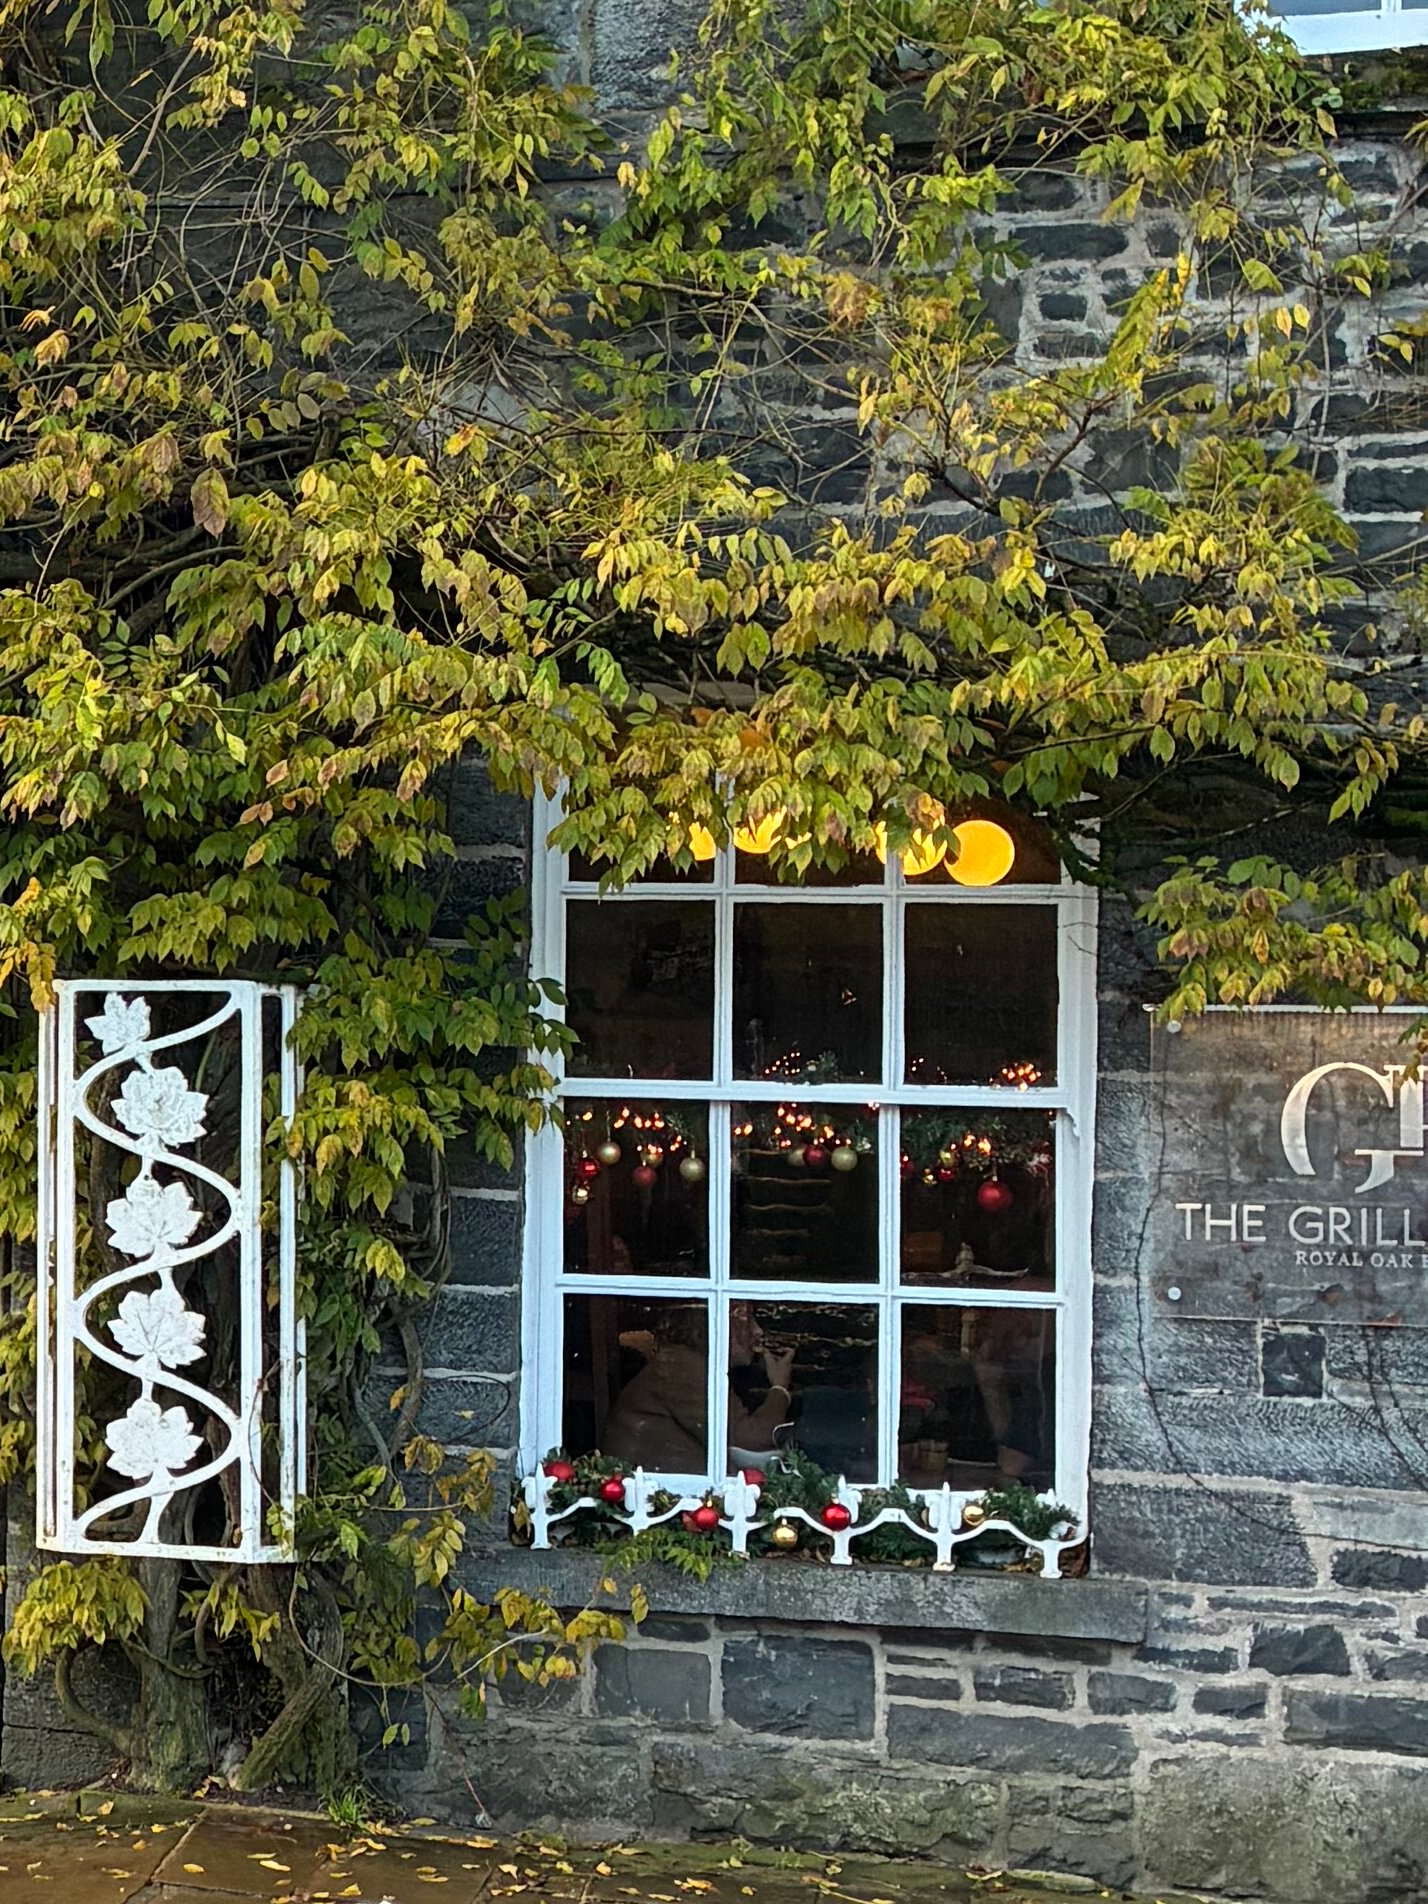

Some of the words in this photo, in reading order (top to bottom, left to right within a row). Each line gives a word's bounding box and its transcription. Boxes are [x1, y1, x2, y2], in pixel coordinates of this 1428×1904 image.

[1175, 1203, 1266, 1242] THE
[1288, 1205, 1427, 1247] GRILL
[1296, 1250, 1364, 1268] ROYAL
[1370, 1252, 1413, 1269] OAK
